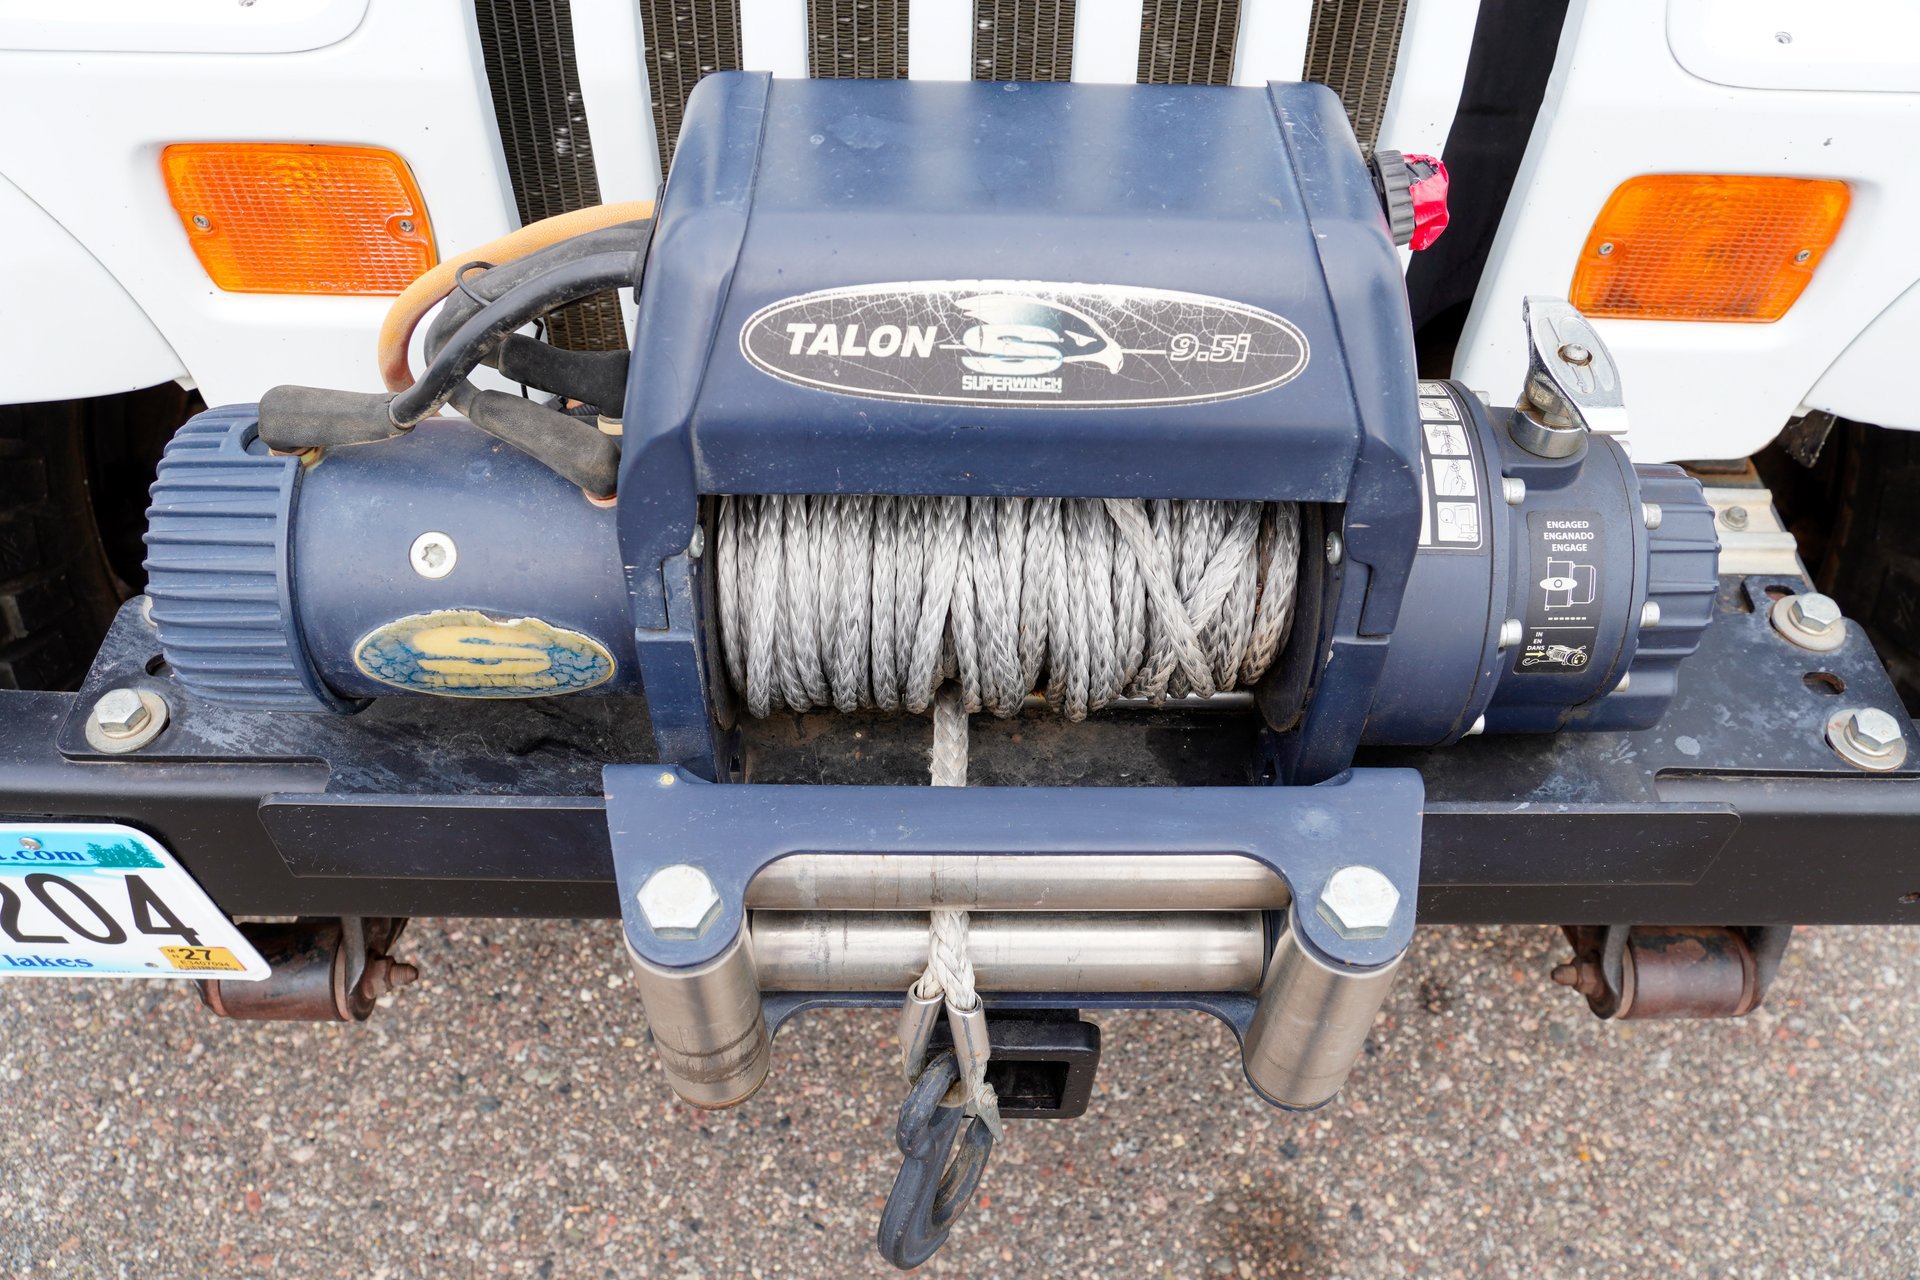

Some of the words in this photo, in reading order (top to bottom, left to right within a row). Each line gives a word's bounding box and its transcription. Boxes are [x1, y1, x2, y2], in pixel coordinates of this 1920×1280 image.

[785, 322, 938, 359] TALON
[1168, 332, 1251, 364] 9.5i
[961, 375, 1063, 393] SUPERWINCH
[1546, 520, 1589, 529] ENGAGED
[1543, 532, 1595, 540] ENGANADO
[1551, 543, 1588, 552] ENGAGE
[0, 850, 87, 861] .com
[178, 948, 212, 961] 27
[2, 954, 94, 969] lakes
